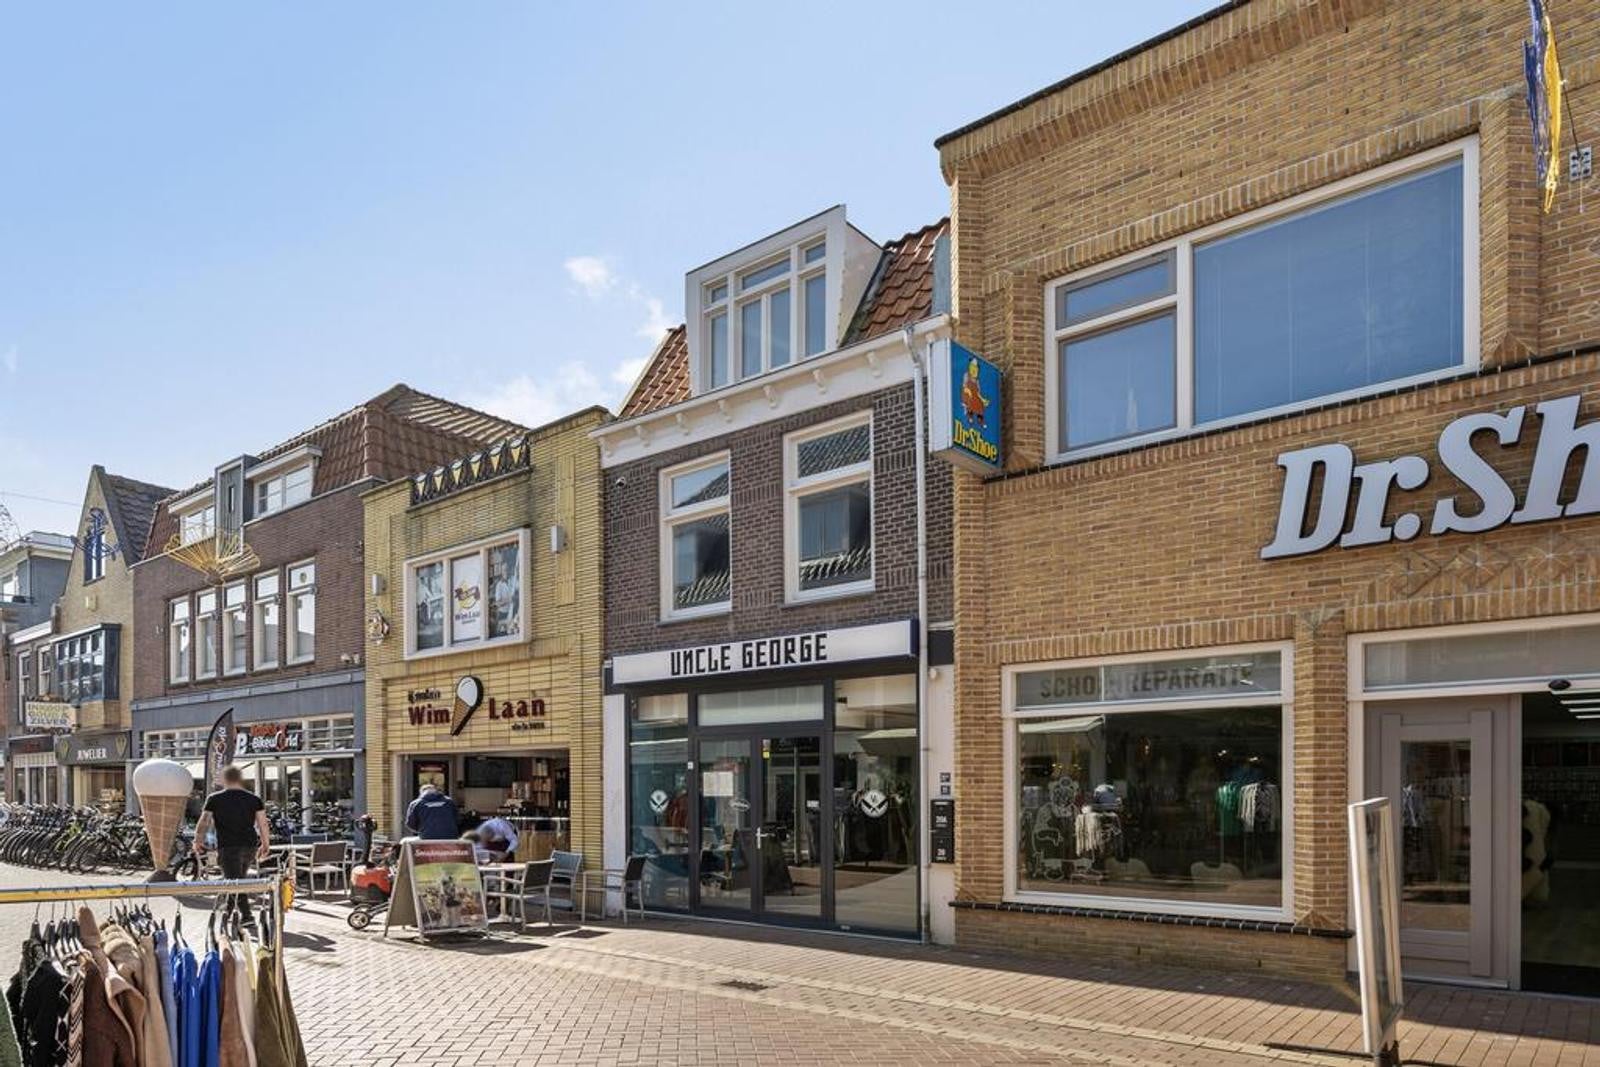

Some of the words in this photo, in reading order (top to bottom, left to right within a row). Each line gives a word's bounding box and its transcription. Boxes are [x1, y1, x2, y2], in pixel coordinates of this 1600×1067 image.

[670, 645, 731, 676] UNCLE
[742, 632, 828, 669] GEORGE
[408, 703, 450, 726] Wim
[489, 698, 545, 720] Laan
[76, 747, 108, 760] JUWELIER
